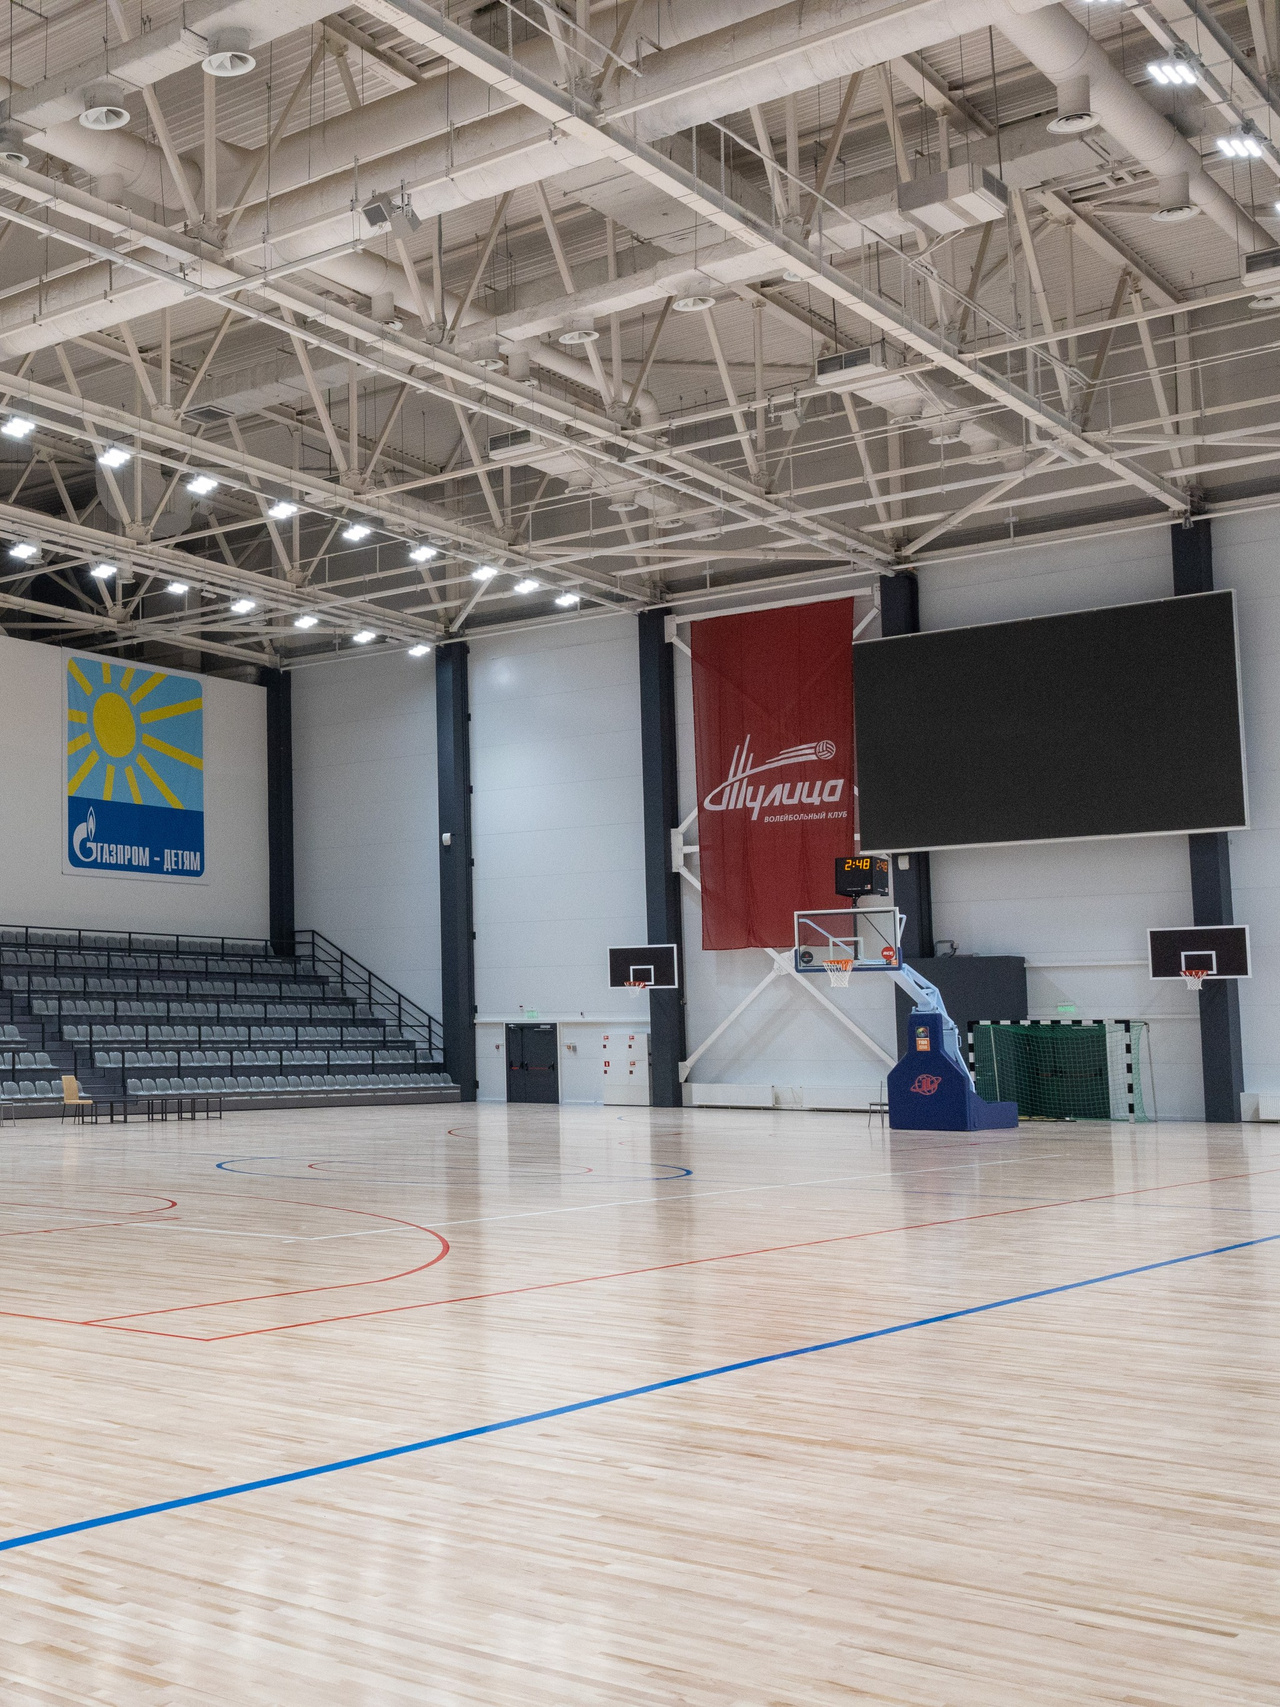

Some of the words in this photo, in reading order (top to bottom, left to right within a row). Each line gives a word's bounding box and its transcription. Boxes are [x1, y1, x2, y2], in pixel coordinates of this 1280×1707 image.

[764, 811, 826, 823] ВОЛЕЙБОЛЬНЫЙ
[827, 810, 848, 819] КЛУБ
[97, 842, 150, 867] ГАЗПРОМ
[163, 849, 201, 872] ДЕТЯМ
[844, 858, 870, 871] 2:48
